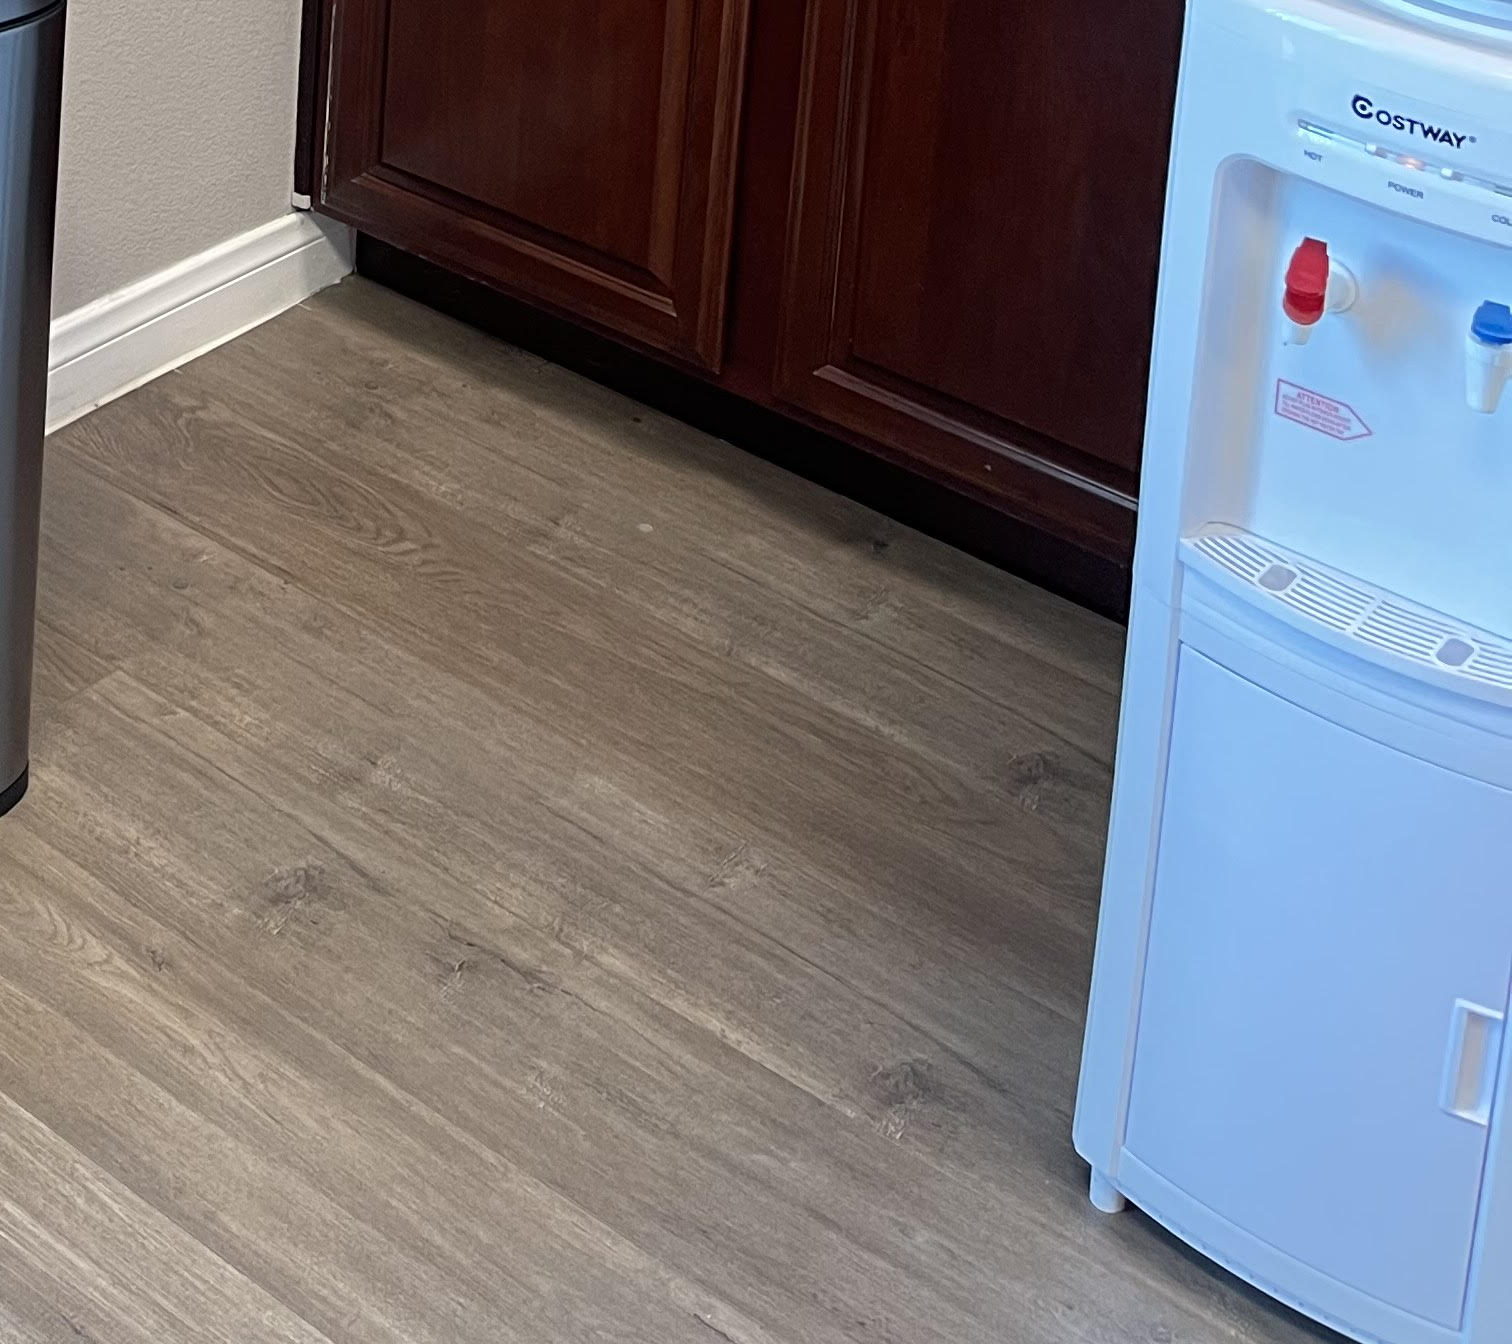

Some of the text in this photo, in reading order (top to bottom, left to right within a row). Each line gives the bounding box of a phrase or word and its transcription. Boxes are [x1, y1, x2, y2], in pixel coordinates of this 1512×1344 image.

[1351, 94, 1467, 149] COSTWAY
[1303, 149, 1324, 162] HOT
[1387, 180, 1424, 199] POWER
[1491, 214, 1512, 226] COL
